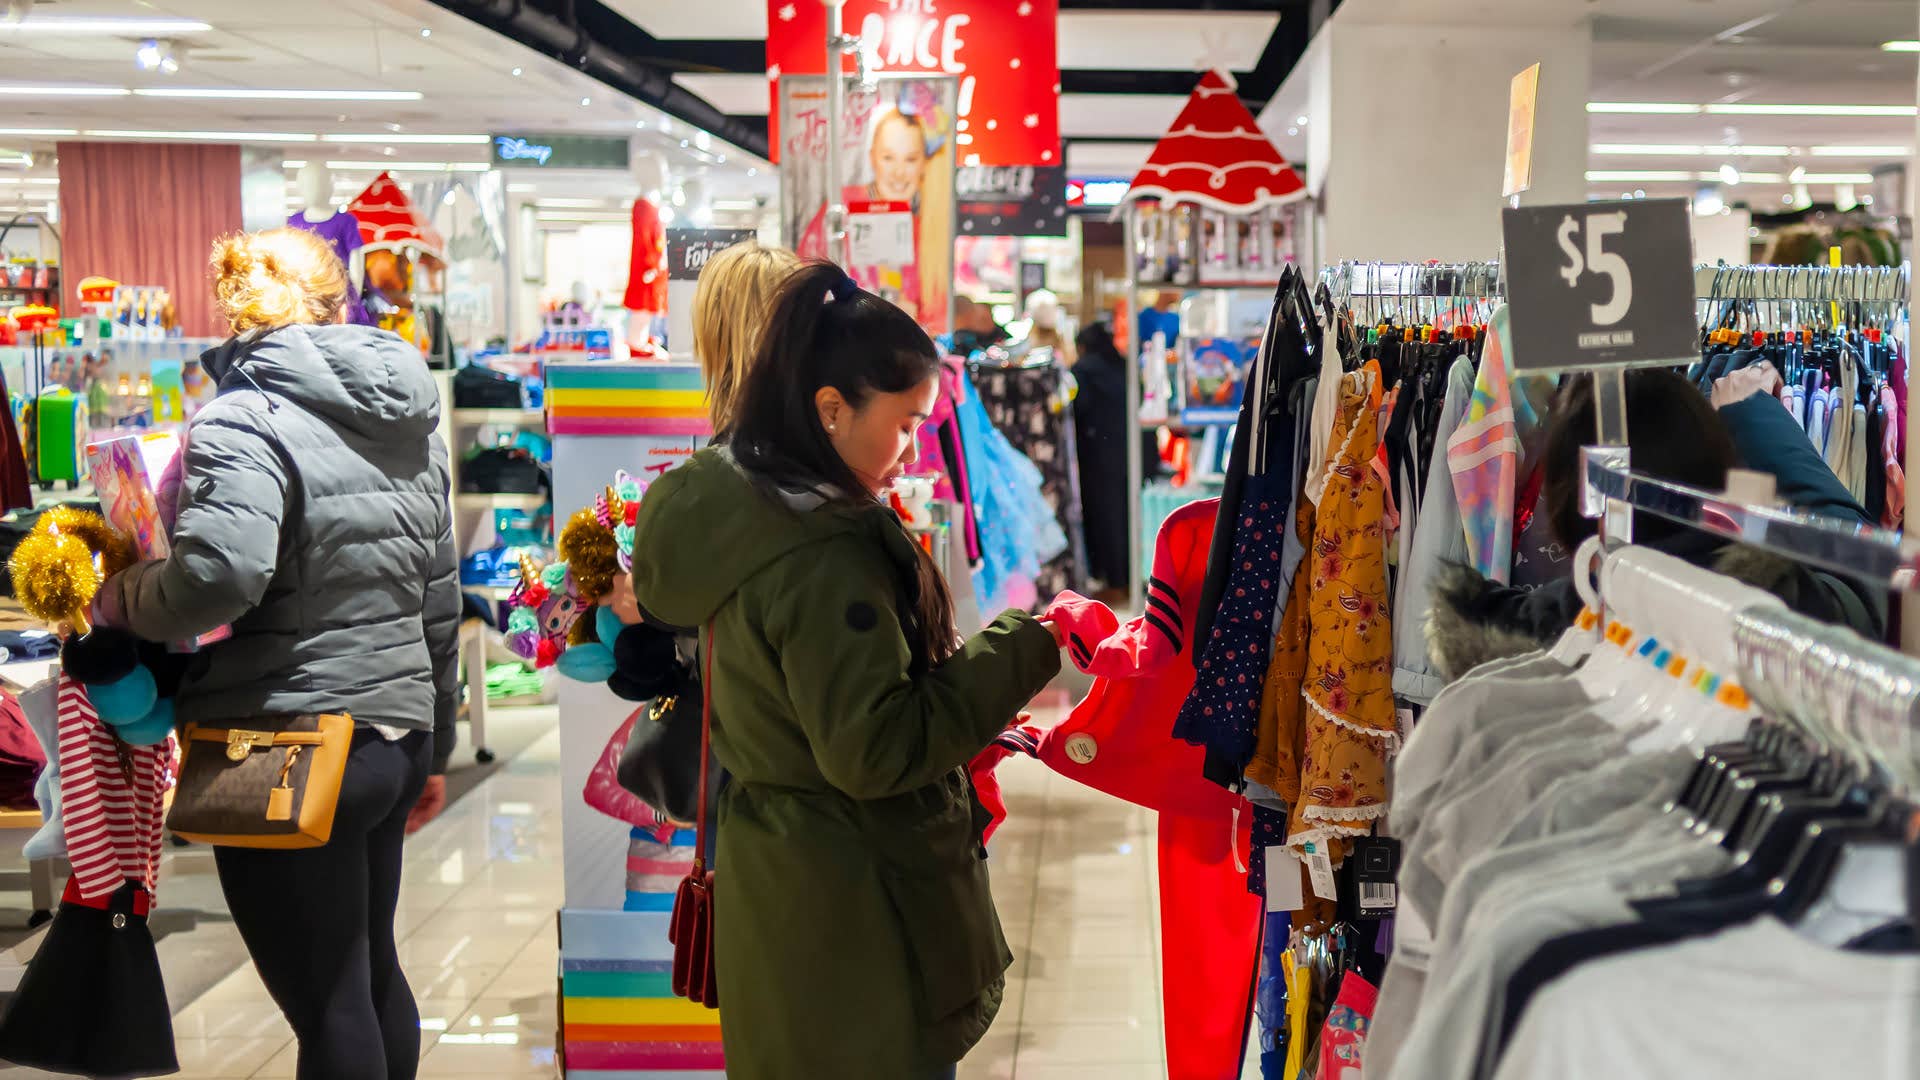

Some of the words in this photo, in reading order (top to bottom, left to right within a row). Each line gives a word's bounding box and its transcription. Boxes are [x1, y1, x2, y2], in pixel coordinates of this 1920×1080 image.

[861, 13, 971, 73] RACE
[494, 136, 552, 165] Disney
[1557, 210, 1633, 326] $5
[1578, 334, 1610, 348] EXTREME
[1611, 331, 1633, 346] VALUE
